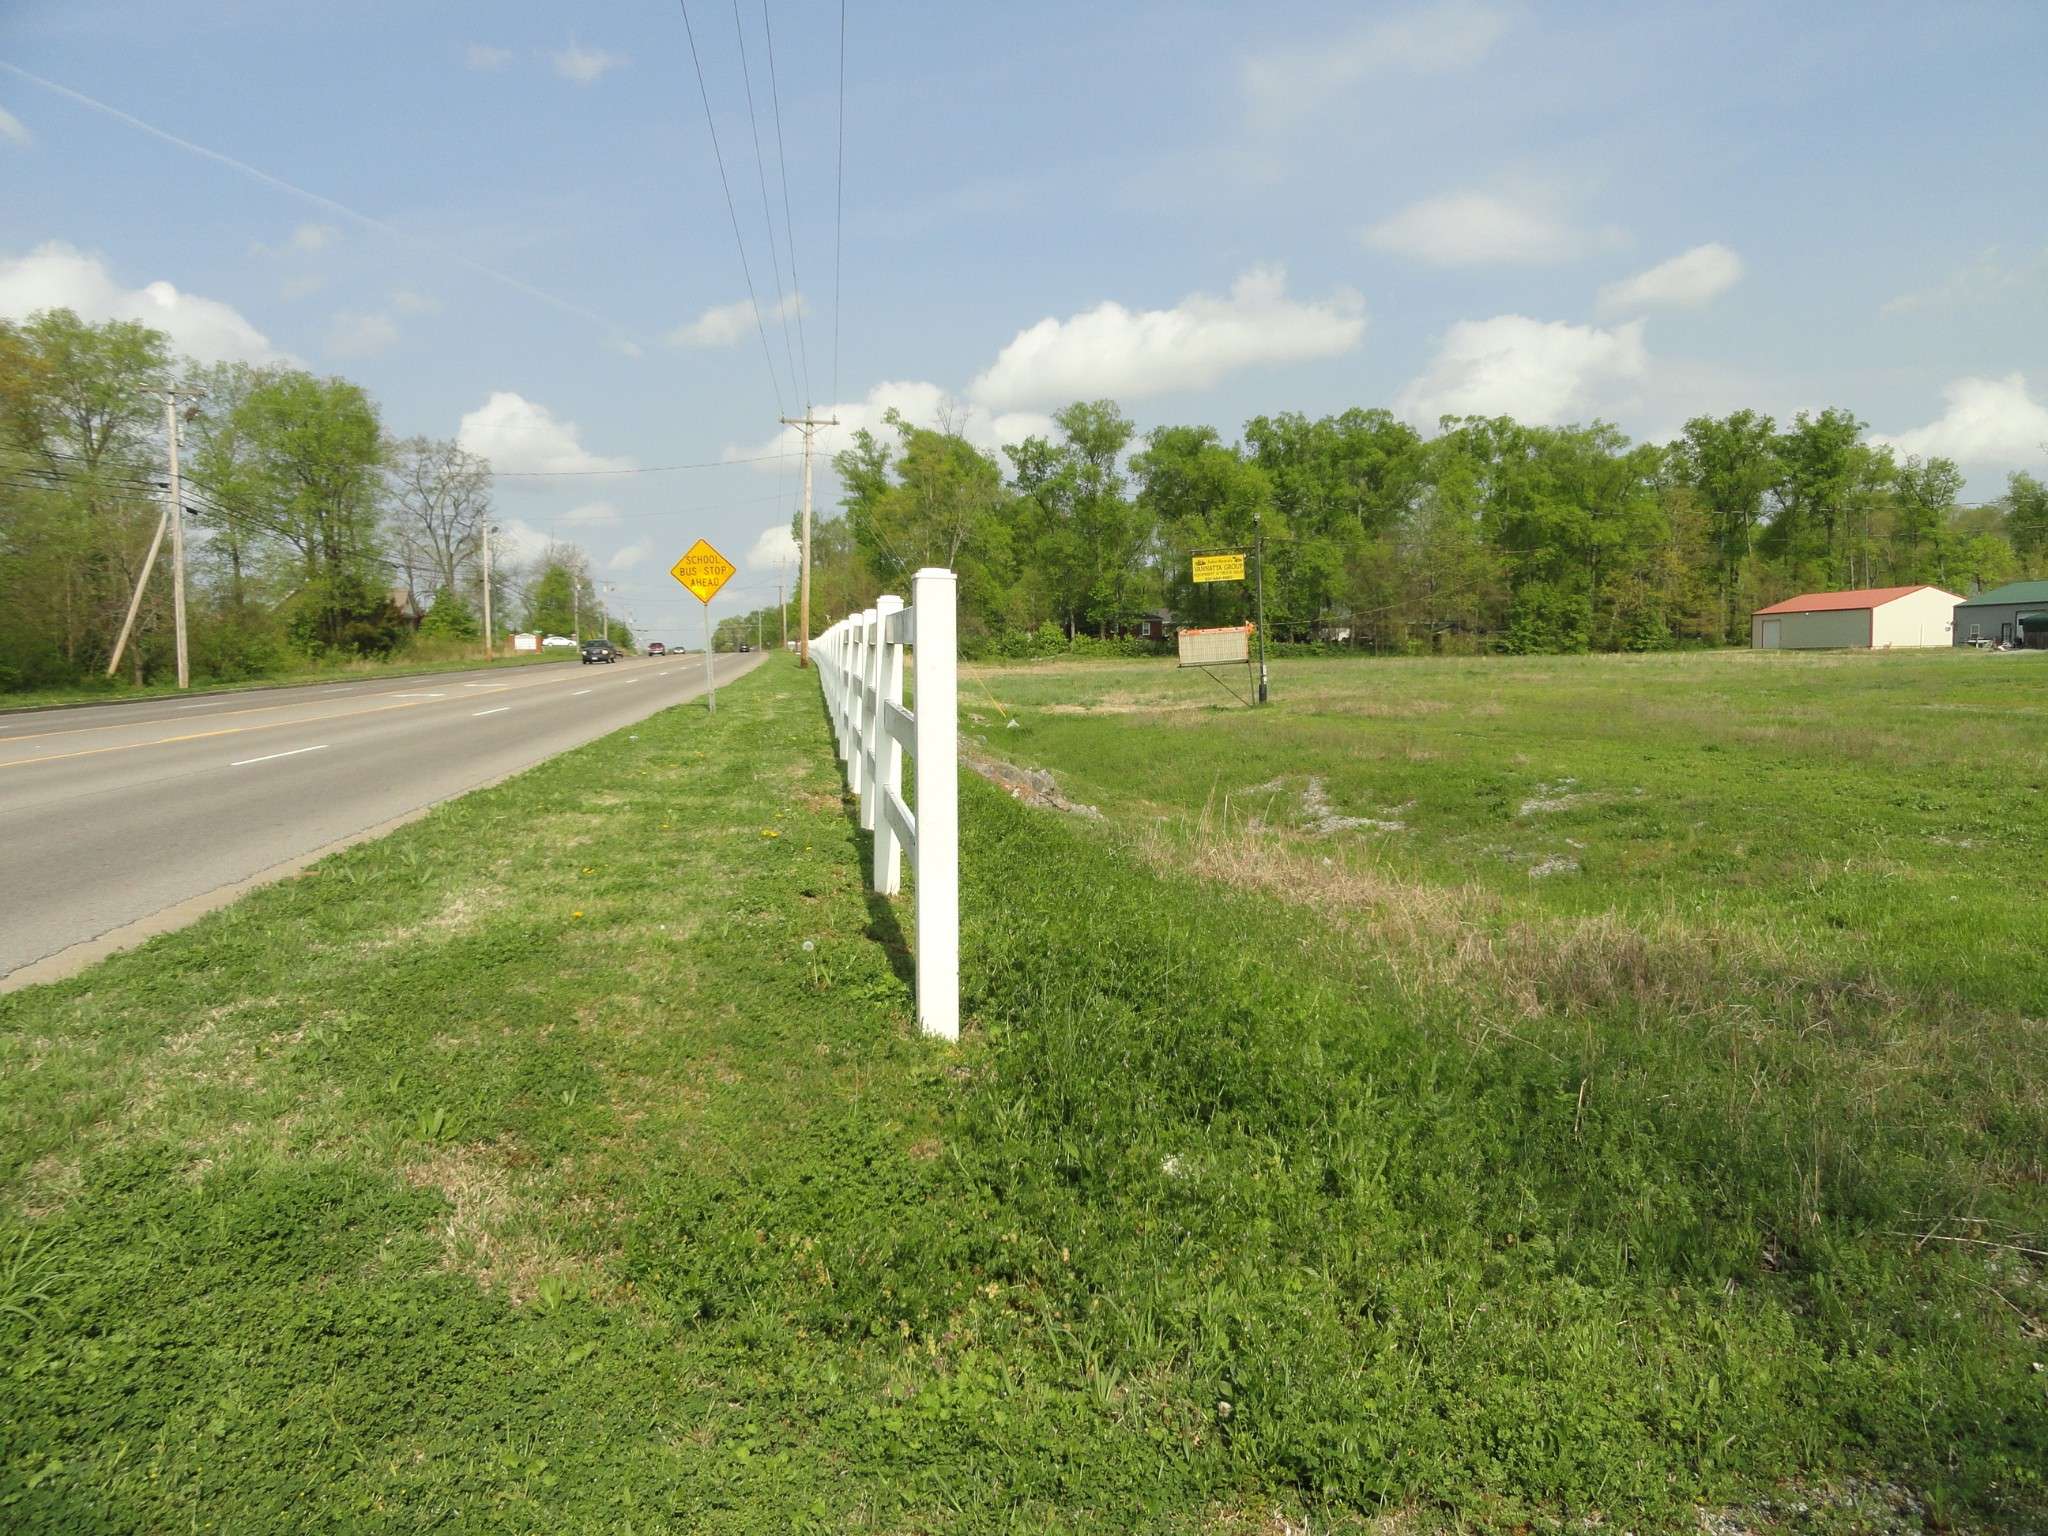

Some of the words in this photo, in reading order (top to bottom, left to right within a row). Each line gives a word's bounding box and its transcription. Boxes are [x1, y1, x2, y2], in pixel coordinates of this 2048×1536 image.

[686, 555, 720, 565] SCHOOL
[680, 567, 697, 576] BUS
[703, 566, 727, 575] STOP
[690, 578, 720, 587] AHEAD
